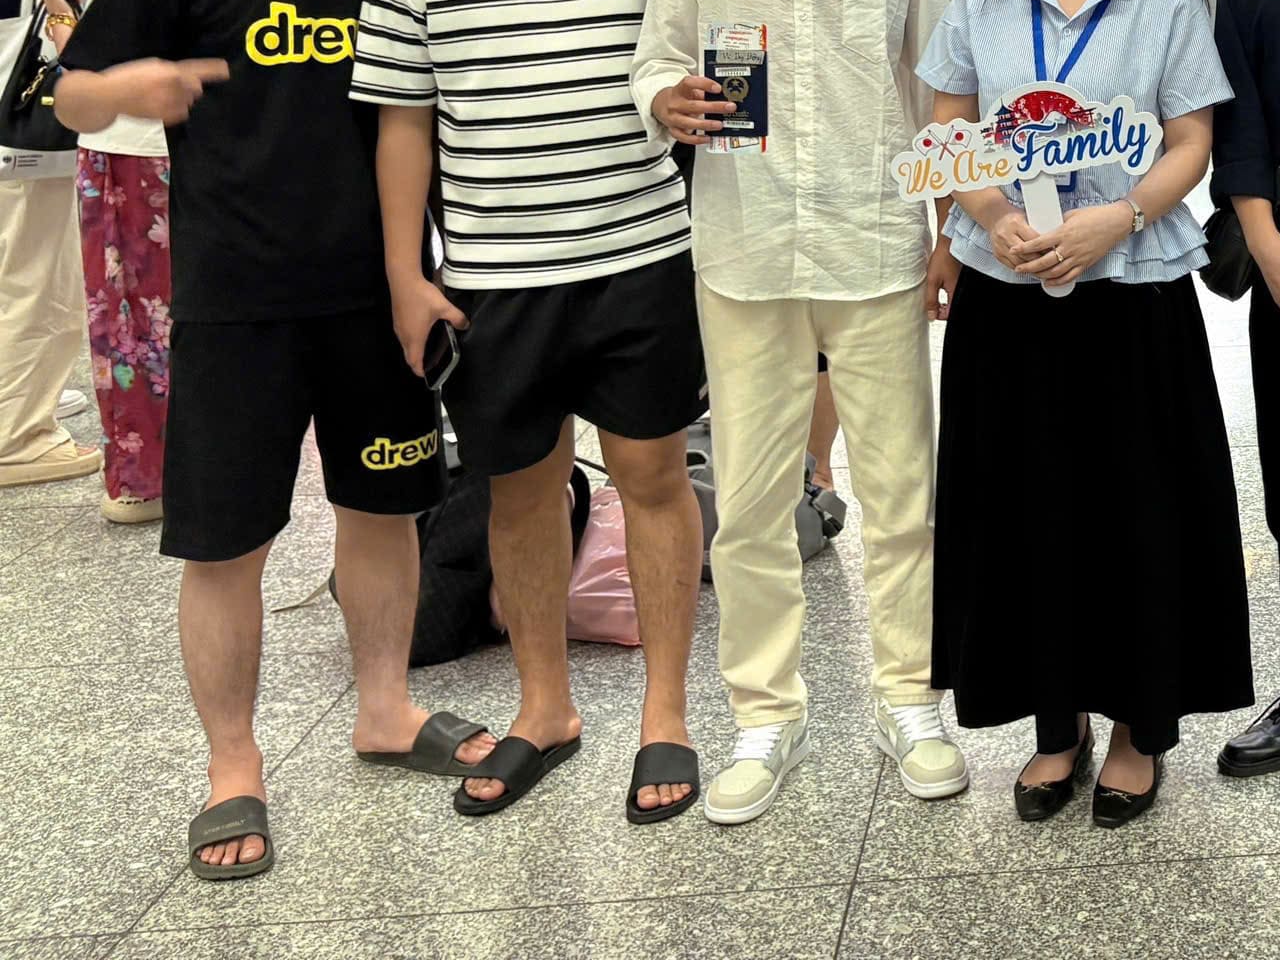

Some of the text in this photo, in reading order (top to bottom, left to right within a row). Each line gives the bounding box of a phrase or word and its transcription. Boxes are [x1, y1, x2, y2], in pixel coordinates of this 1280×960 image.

[899, 106, 1152, 195] We Are Family
[361, 428, 438, 470] drew
